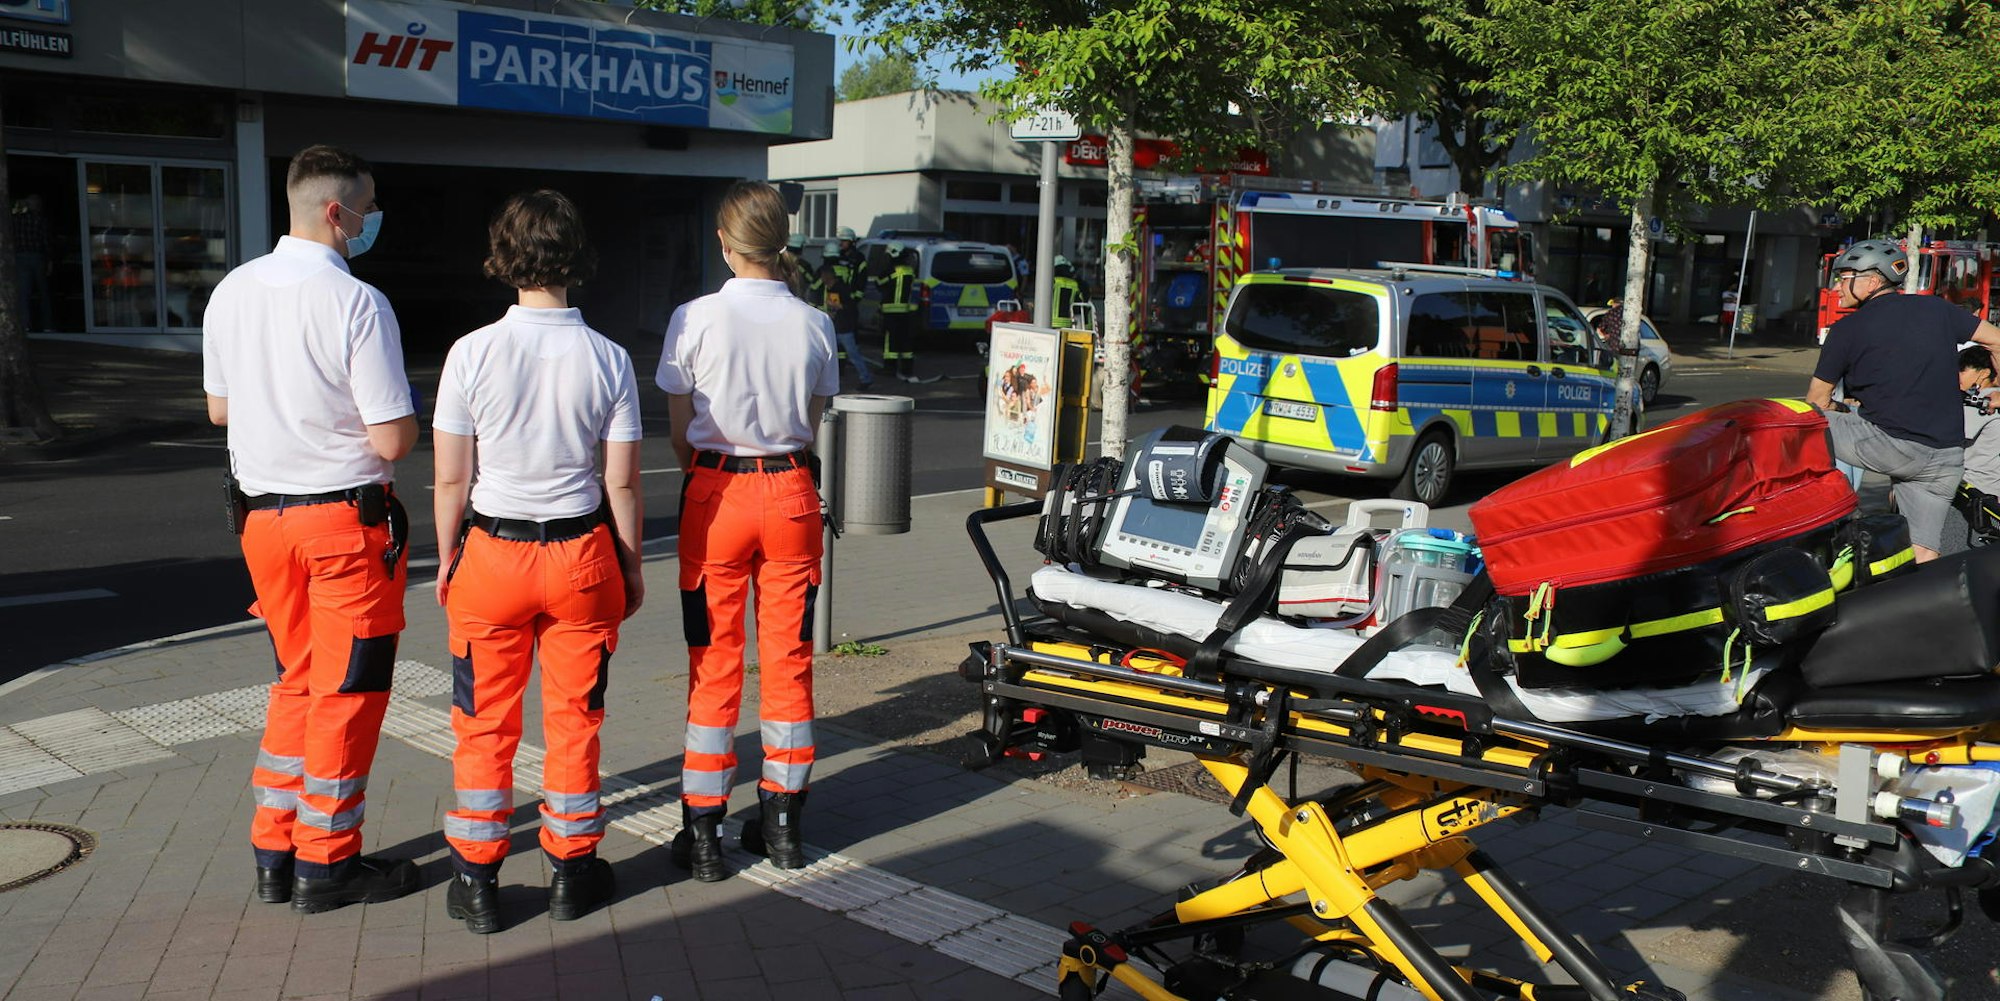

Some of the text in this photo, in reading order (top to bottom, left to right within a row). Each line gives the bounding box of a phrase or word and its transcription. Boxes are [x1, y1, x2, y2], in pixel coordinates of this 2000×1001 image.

[469, 40, 704, 101] PARKHAUS
[732, 72, 790, 95] Hennef
[1220, 359, 1270, 378] POLIZEI
[1558, 385, 1592, 400] POLIZEI
